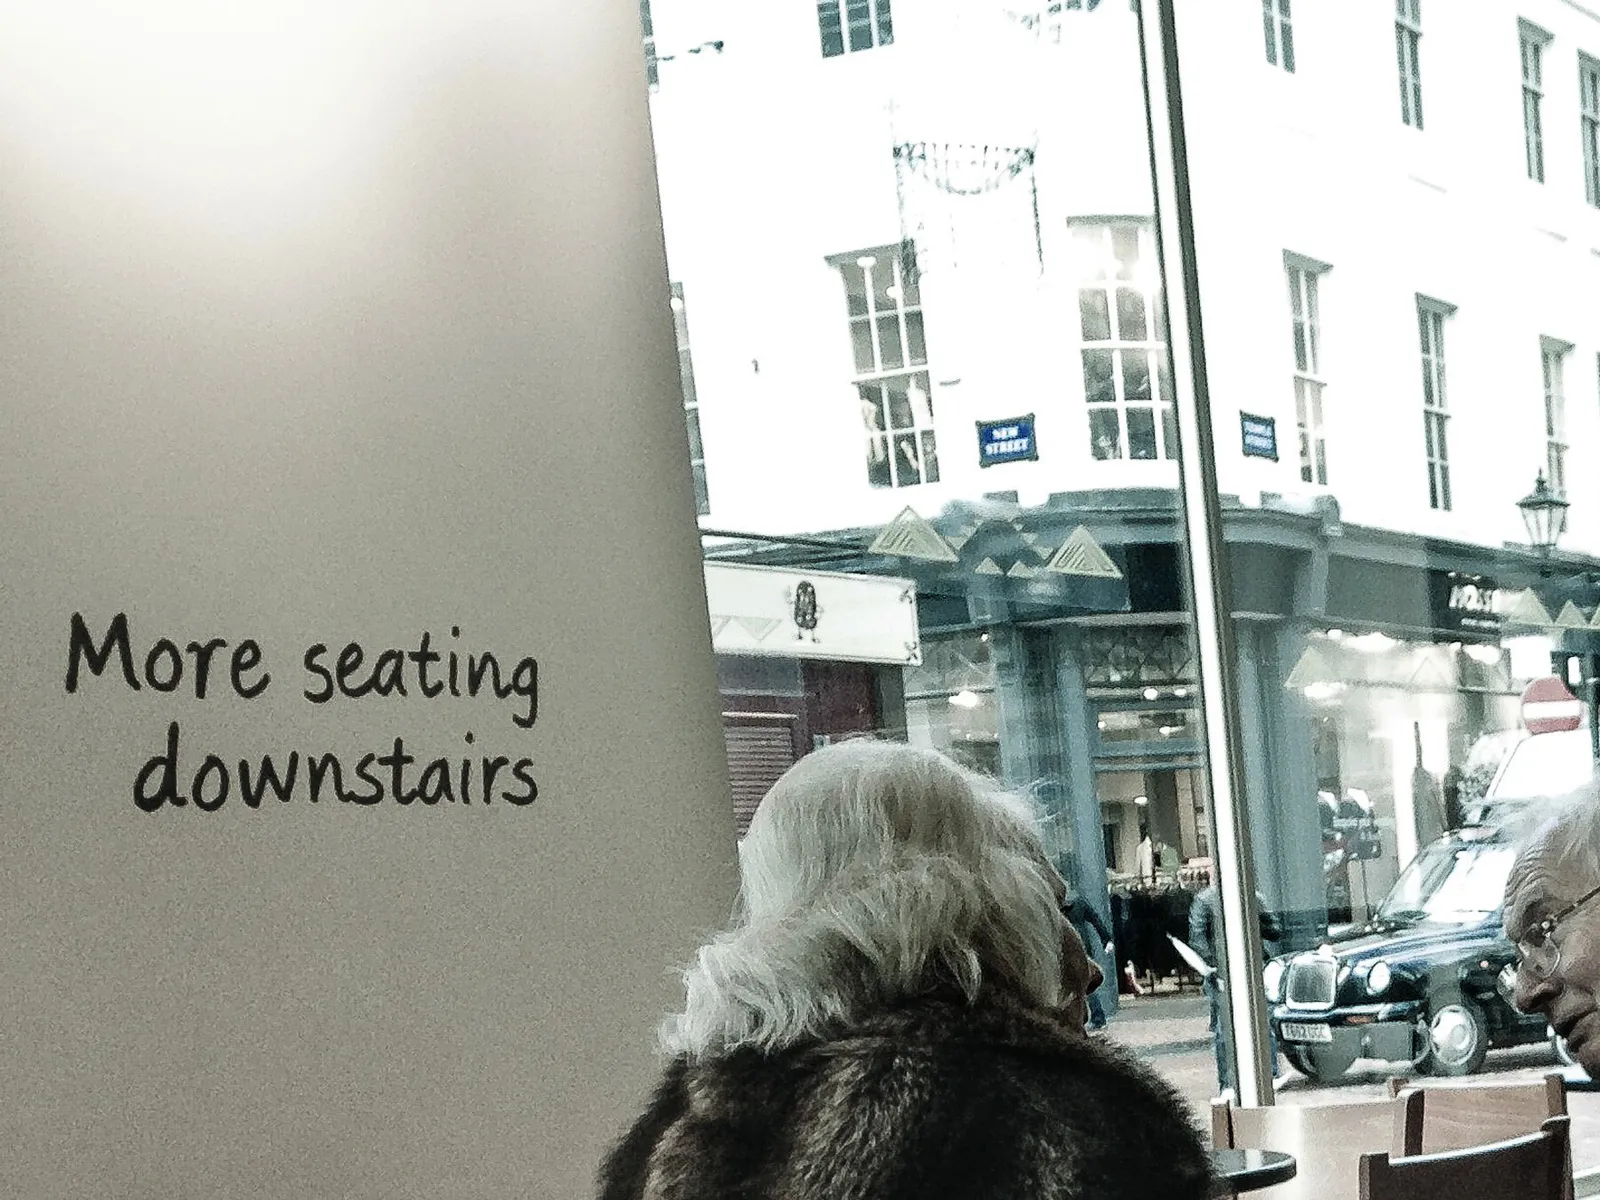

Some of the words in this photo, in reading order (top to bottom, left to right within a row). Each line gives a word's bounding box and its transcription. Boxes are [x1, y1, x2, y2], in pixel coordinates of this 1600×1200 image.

[984, 437, 1029, 456] STREET
[991, 425, 1019, 441] NEW
[64, 611, 272, 700] More
[302, 625, 541, 729] seating
[132, 720, 541, 813] downstairs
